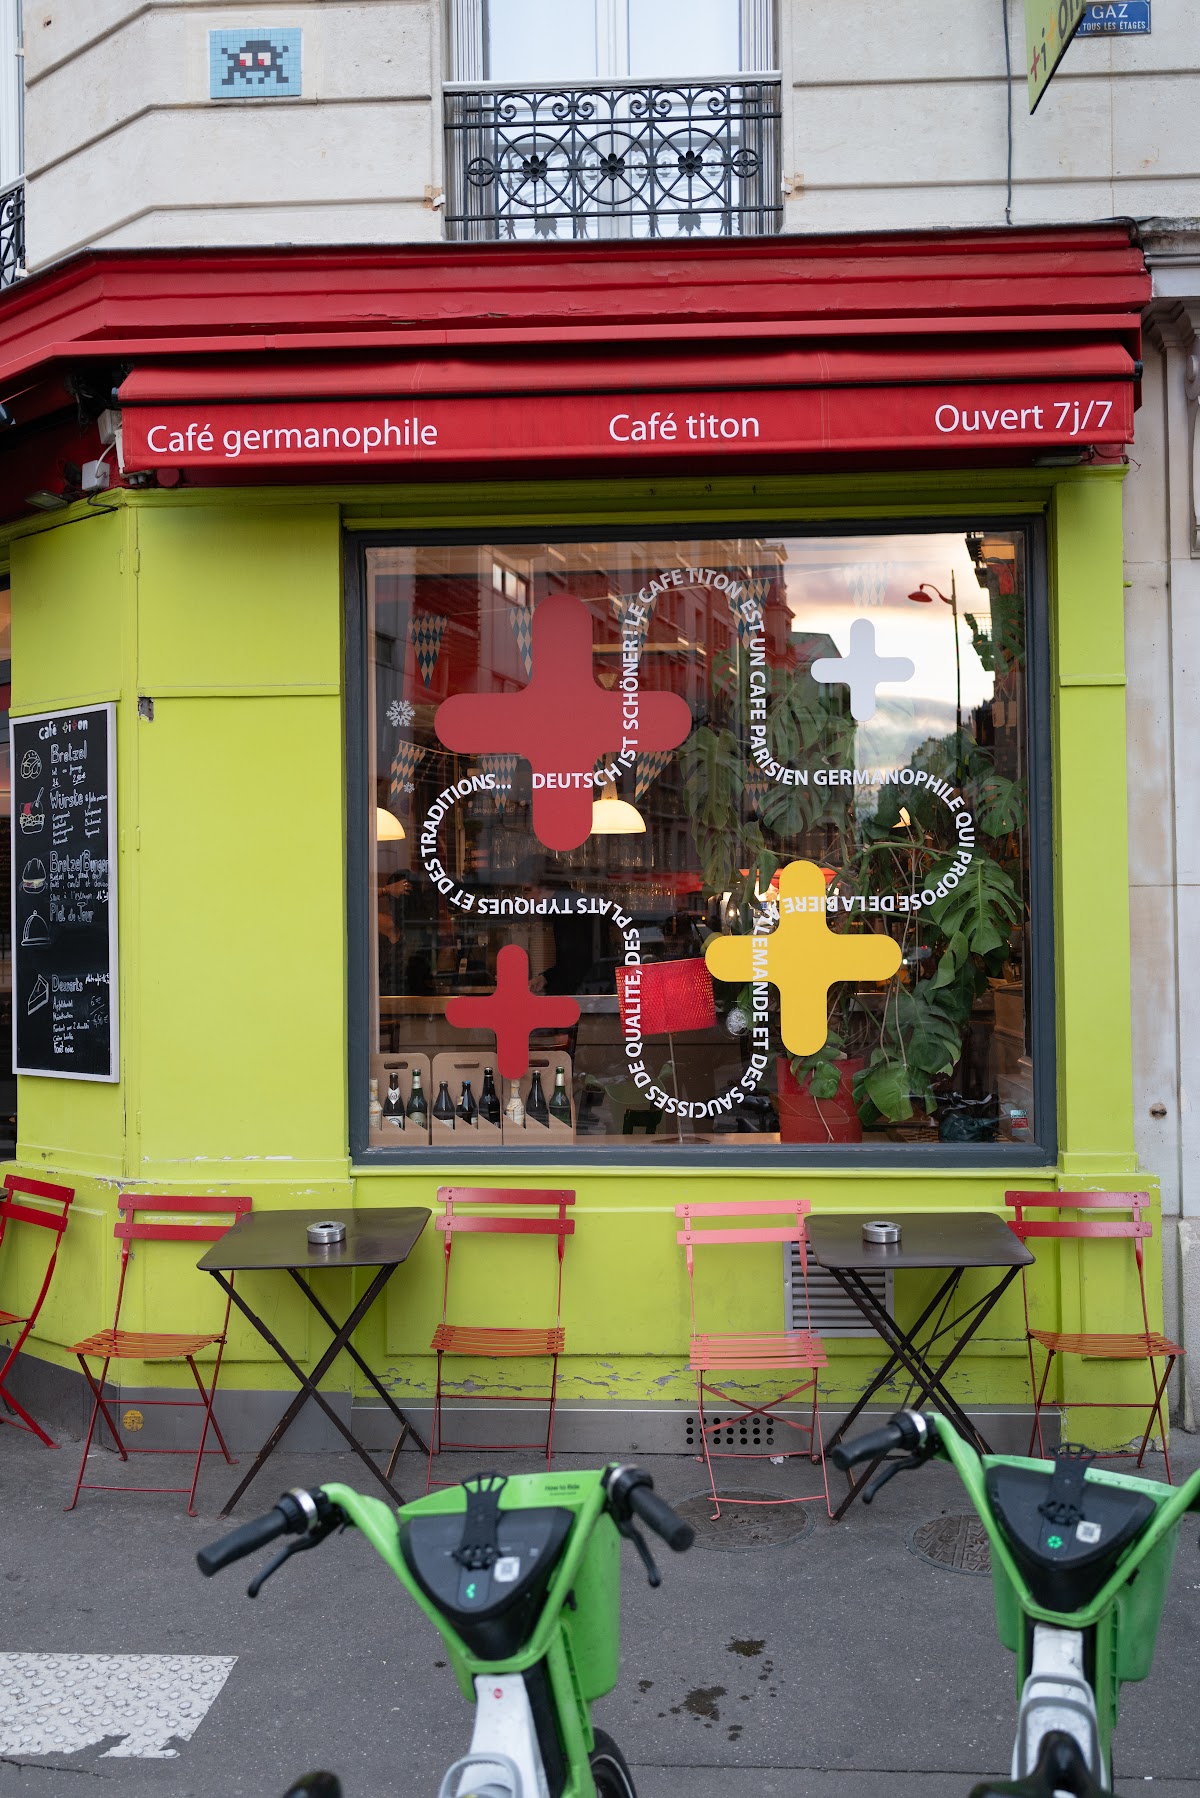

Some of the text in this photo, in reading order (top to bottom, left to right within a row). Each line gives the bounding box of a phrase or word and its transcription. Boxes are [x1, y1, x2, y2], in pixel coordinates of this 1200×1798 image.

[1082, 22, 1101, 31] TOUS
[1104, 22, 1117, 31] LES
[1119, 20, 1146, 30] ÉTAGES
[1091, 4, 1129, 19] GAZ
[609, 411, 760, 442] Café titon
[934, 400, 1113, 436] Ouvert 7j/7
[147, 418, 438, 457] Café germanophile
[638, 569, 684, 603] CAFE
[685, 567, 743, 600] TITON
[624, 602, 646, 627] LE
[739, 598, 766, 633] EST
[749, 638, 766, 666] UN
[749, 670, 766, 720] CAFE
[51, 740, 87, 764] Bretzel
[617, 736, 639, 769] IST
[750, 725, 809, 786] PARISIEN
[532, 762, 623, 789] DEUTSCH
[813, 768, 966, 812] GERMANOPHILE
[50, 789, 84, 809] Würste
[420, 773, 512, 858] TRADITIONS...
[955, 811, 975, 848] QUI
[424, 858, 455, 895] DES
[898, 850, 973, 912] PROPOSE
[449, 889, 476, 911] ET
[477, 896, 574, 915] TYPIQUES
[576, 897, 633, 929] PLATS
[782, 895, 839, 914] BIERE
[840, 895, 866, 912] LA
[868, 895, 895, 912] DE
[622, 928, 641, 966] DES
[752, 902, 781, 1022] ALLEMANDE
[52, 974, 83, 992] Desserts
[625, 969, 643, 1058] QUALITE,
[752, 1027, 769, 1051] ET
[627, 1059, 652, 1089] DE
[740, 1053, 769, 1092] DES
[644, 1085, 745, 1119] SAUCISSES
